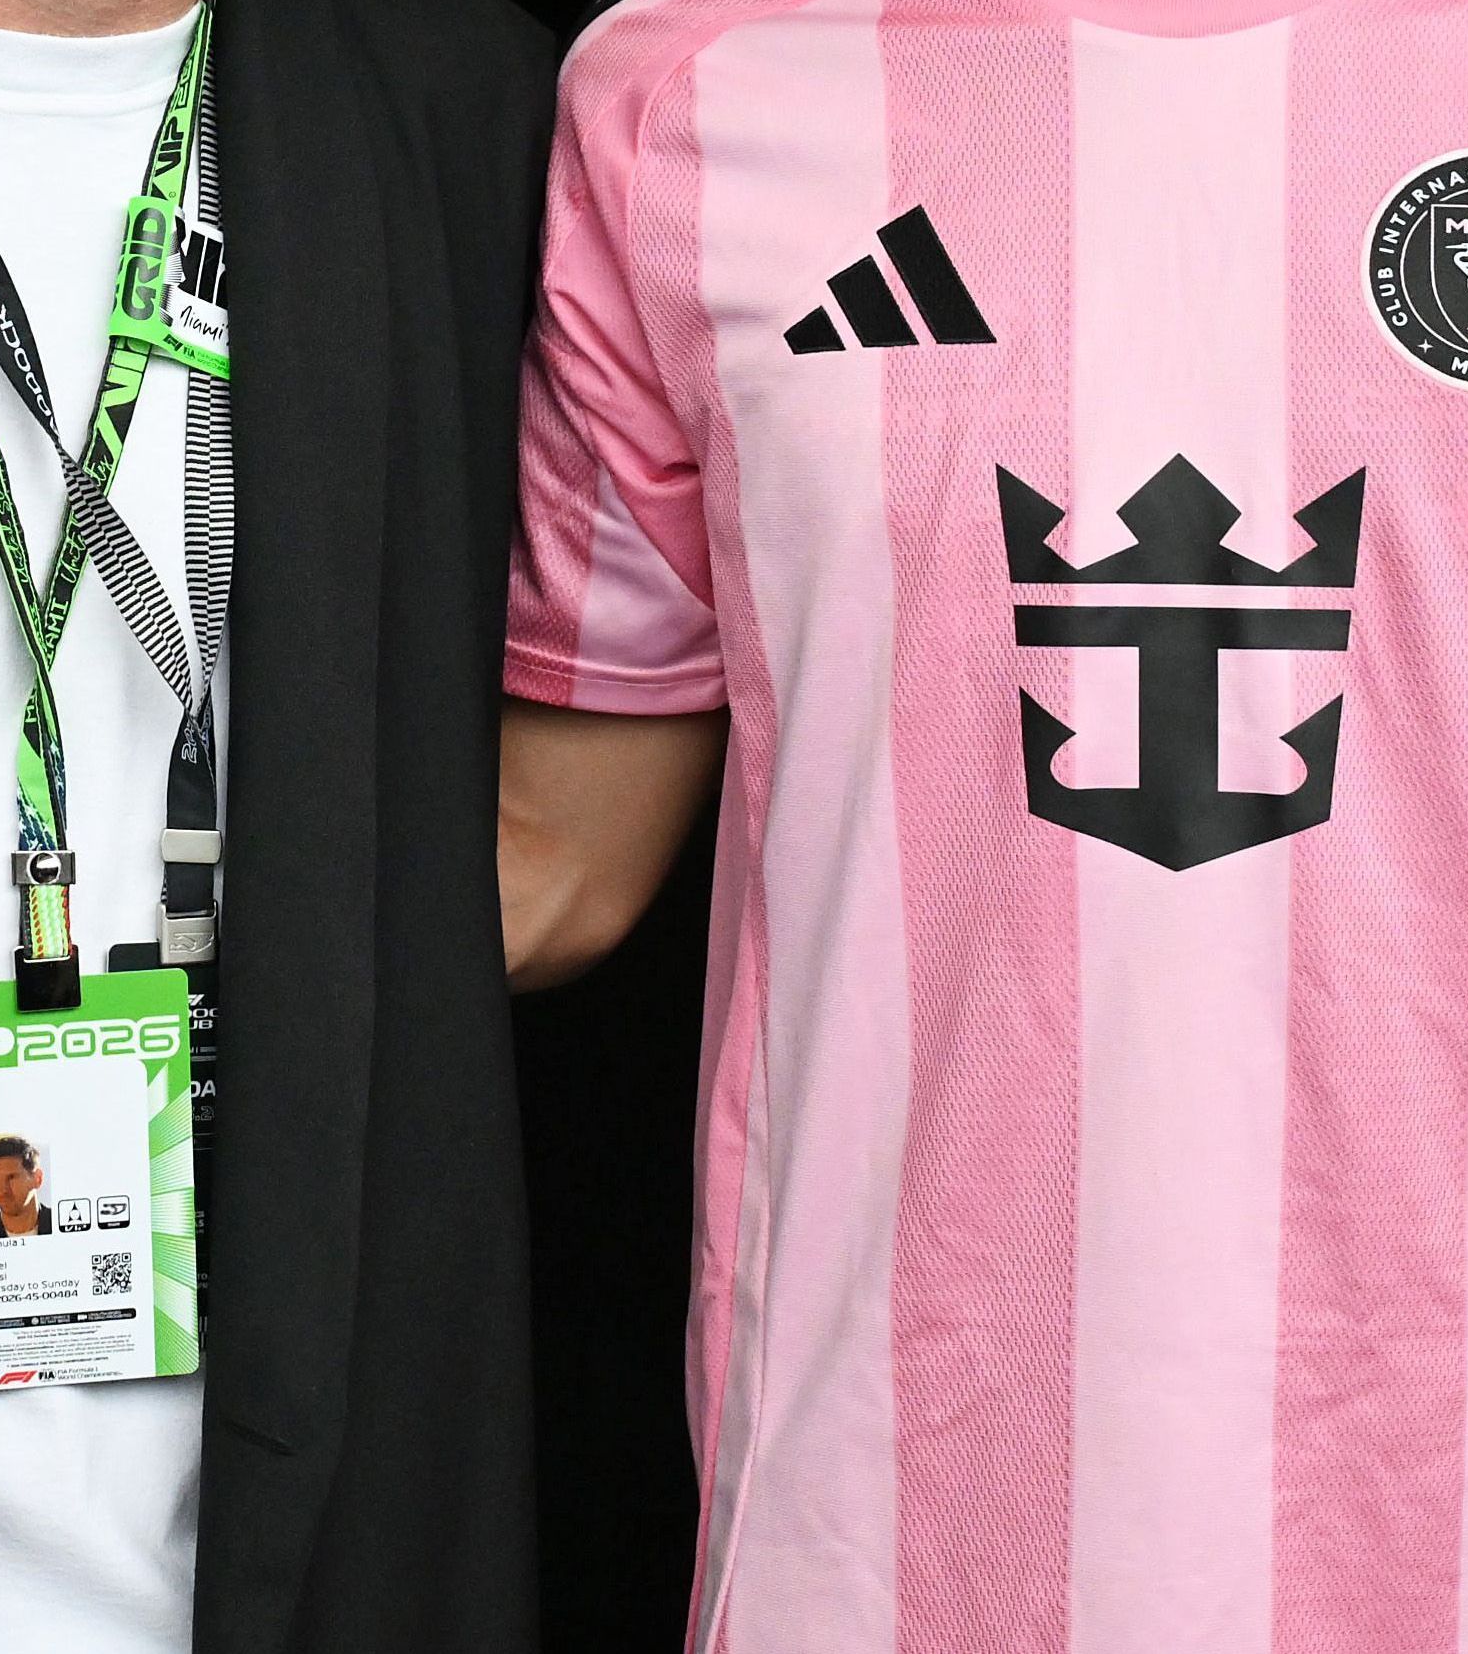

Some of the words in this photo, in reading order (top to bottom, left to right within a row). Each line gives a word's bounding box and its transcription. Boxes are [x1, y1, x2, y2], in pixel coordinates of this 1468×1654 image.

[121, 207, 167, 321] GRID
[1378, 265, 1408, 328] CLUB
[41, 1278, 81, 1291] Sunday
